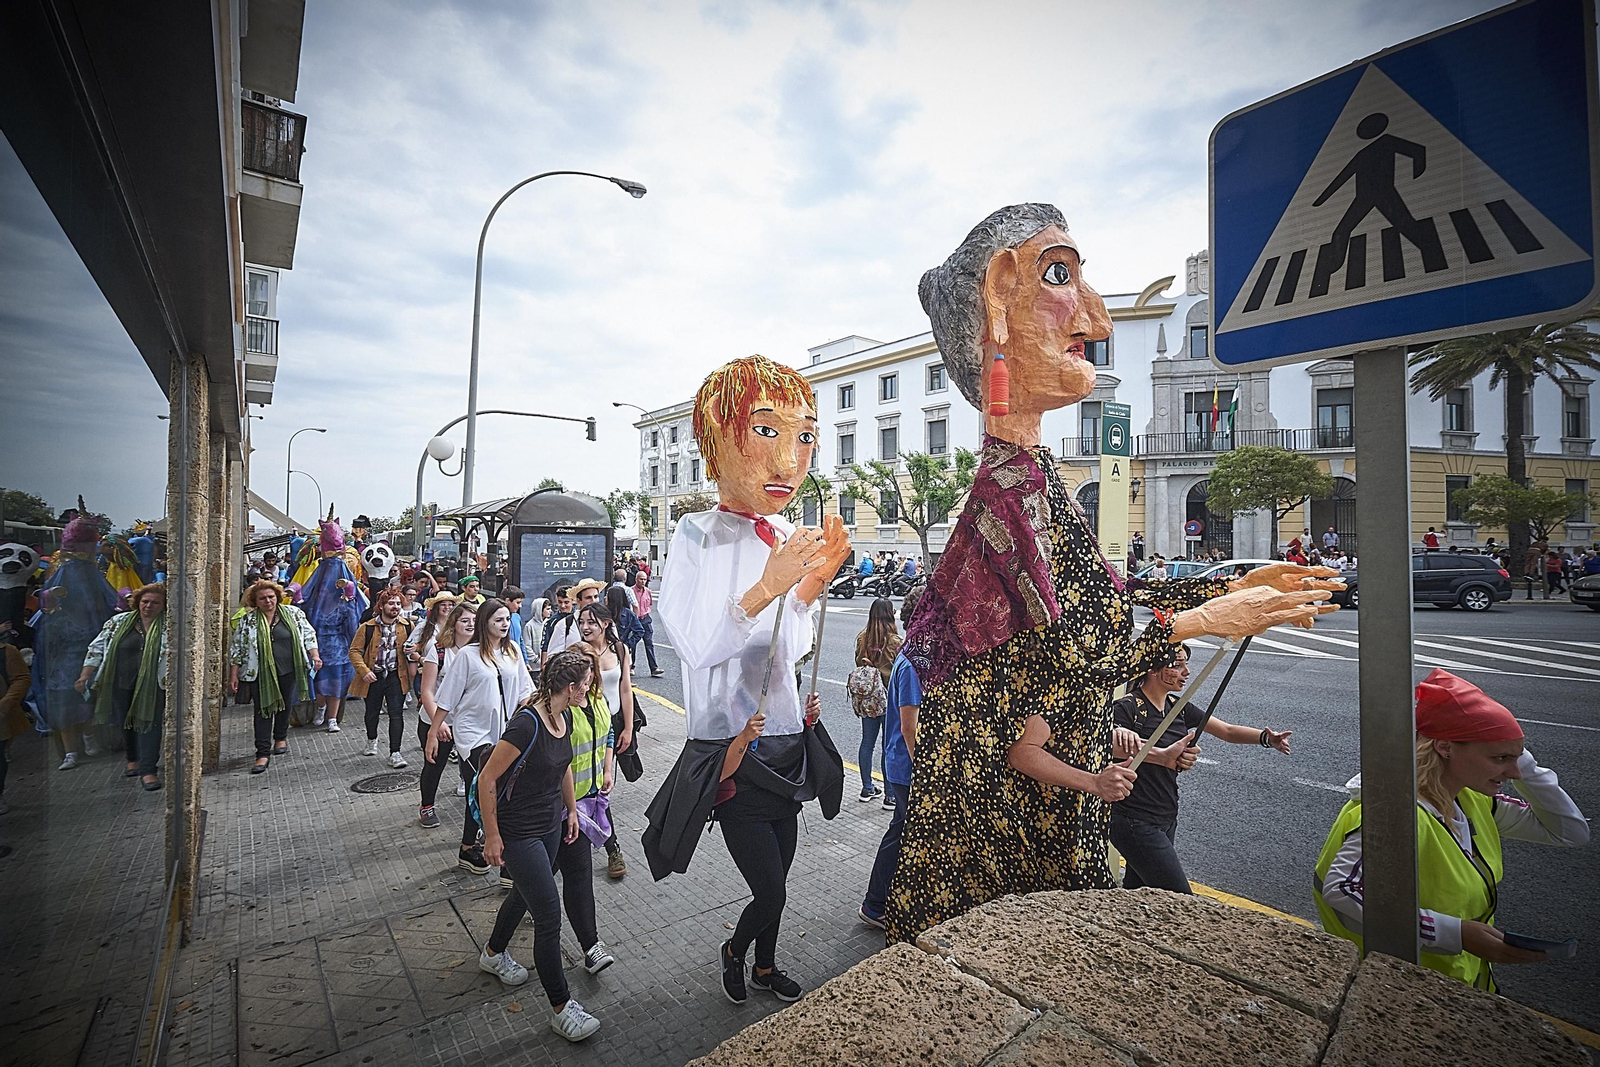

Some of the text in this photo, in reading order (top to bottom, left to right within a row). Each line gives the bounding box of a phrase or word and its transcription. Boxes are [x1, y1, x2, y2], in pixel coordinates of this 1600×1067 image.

[1111, 463, 1120, 476] A
[543, 548, 587, 556] MATAR
[544, 560, 587, 569] PADRE
